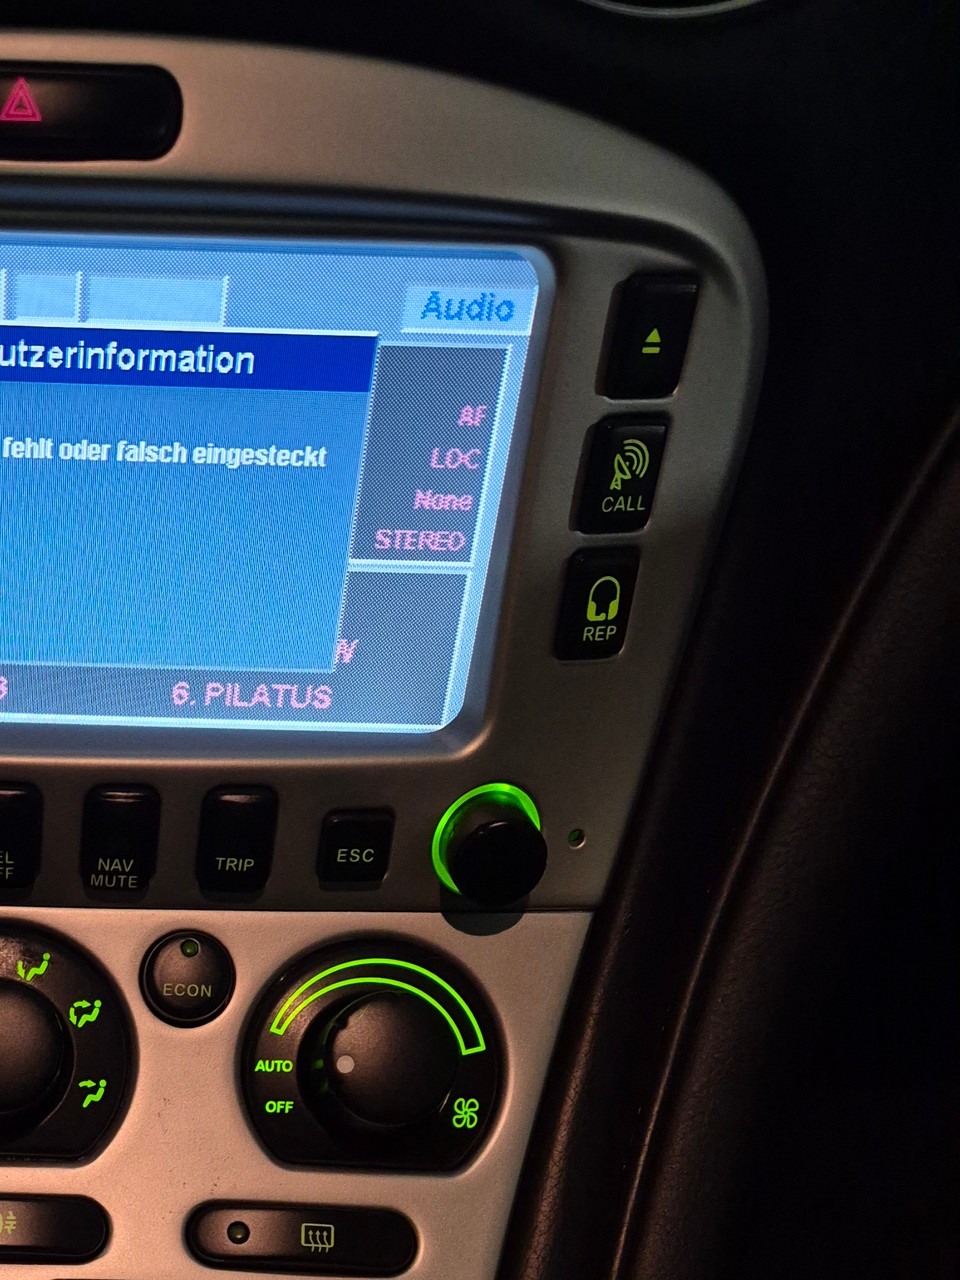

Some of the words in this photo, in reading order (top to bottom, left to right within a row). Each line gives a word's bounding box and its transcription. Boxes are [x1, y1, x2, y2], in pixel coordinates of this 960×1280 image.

[420, 290, 515, 322] Audio
[458, 404, 487, 427] AF
[2, 436, 54, 460] fehlt
[58, 439, 111, 462] oder
[116, 440, 188, 465] falsch
[192, 442, 327, 470] eingesteckt
[431, 447, 481, 471] LOC
[413, 488, 473, 512] None
[601, 496, 646, 513] CALL
[374, 529, 466, 552] STEREO
[582, 625, 617, 642] REP
[171, 680, 197, 707] 6.
[204, 682, 333, 709] PILATUS
[215, 856, 256, 873] TRIP
[336, 848, 375, 864] ESC
[97, 857, 135, 873] NAV
[89, 874, 139, 889] MUTE
[161, 982, 213, 998] ECON
[254, 1059, 294, 1073] AUTO
[265, 1100, 294, 1114] OFF
